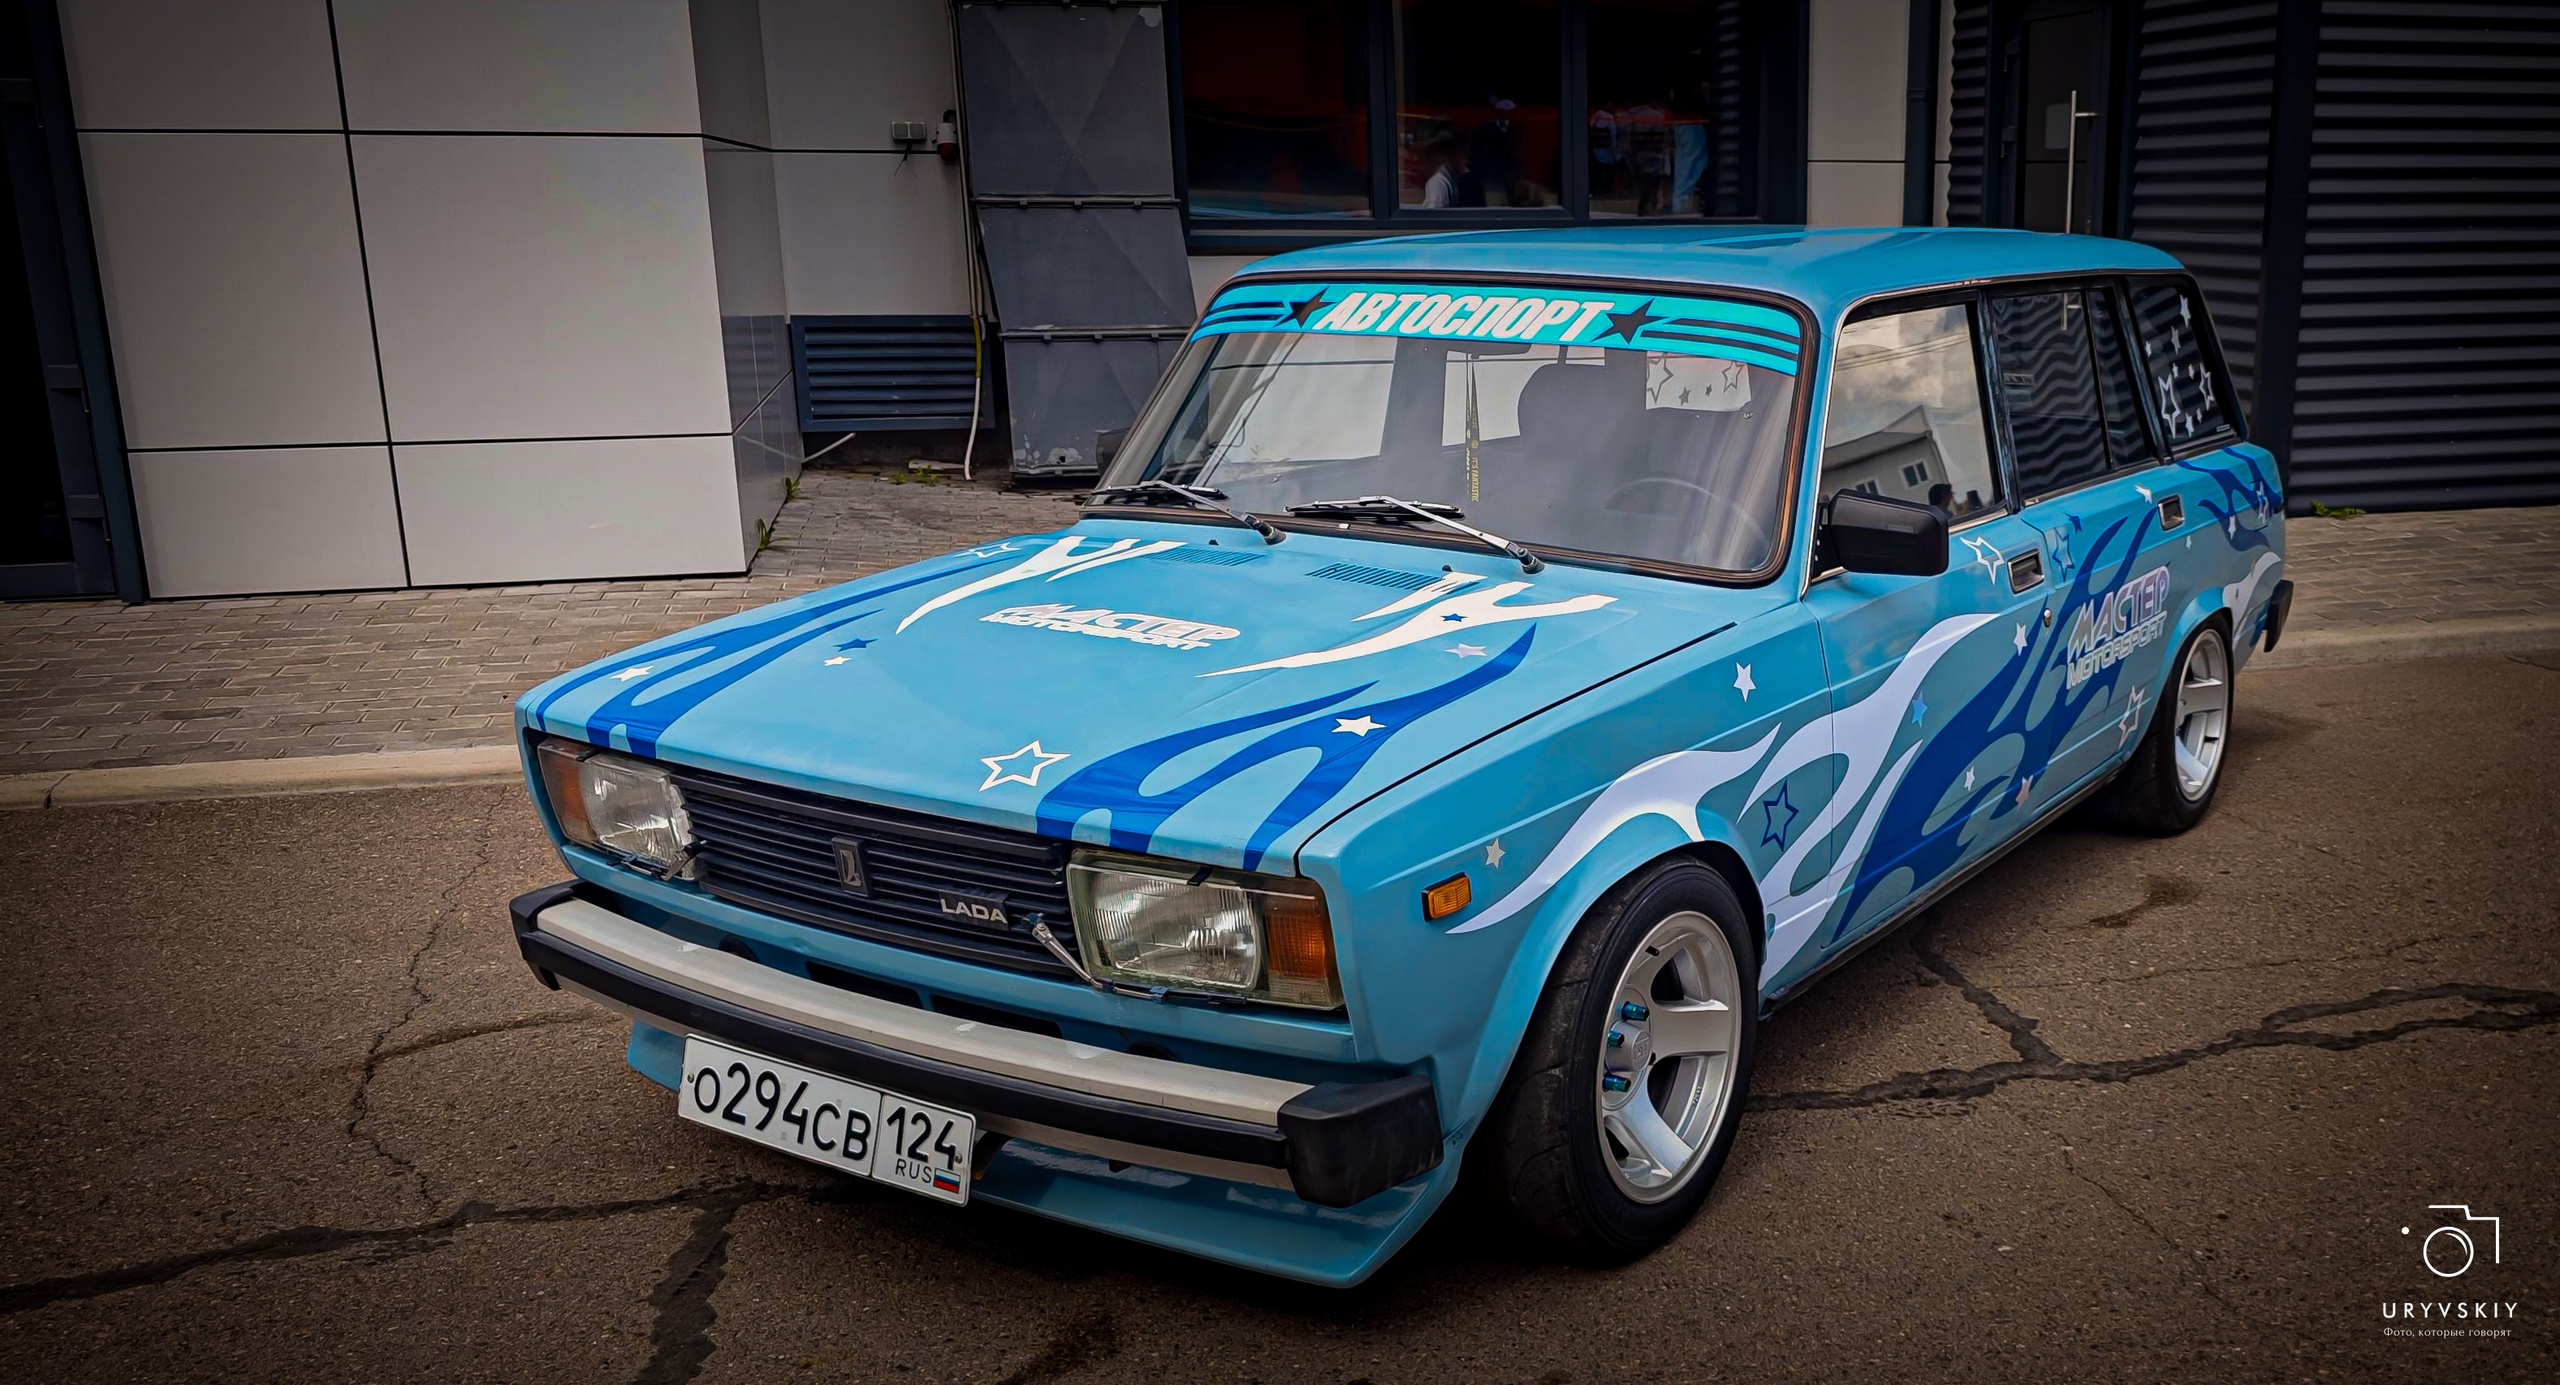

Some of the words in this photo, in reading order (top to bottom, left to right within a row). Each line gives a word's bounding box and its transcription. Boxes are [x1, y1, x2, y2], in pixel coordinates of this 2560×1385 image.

[1312, 292, 1615, 342] АВТОСПОРТ
[2067, 565, 2170, 666] МАСТЕР
[2066, 610, 2167, 690] MOTORSPORT
[940, 898, 1008, 924] LADA
[886, 1105, 957, 1171] 124
[894, 1157, 933, 1184] RUS
